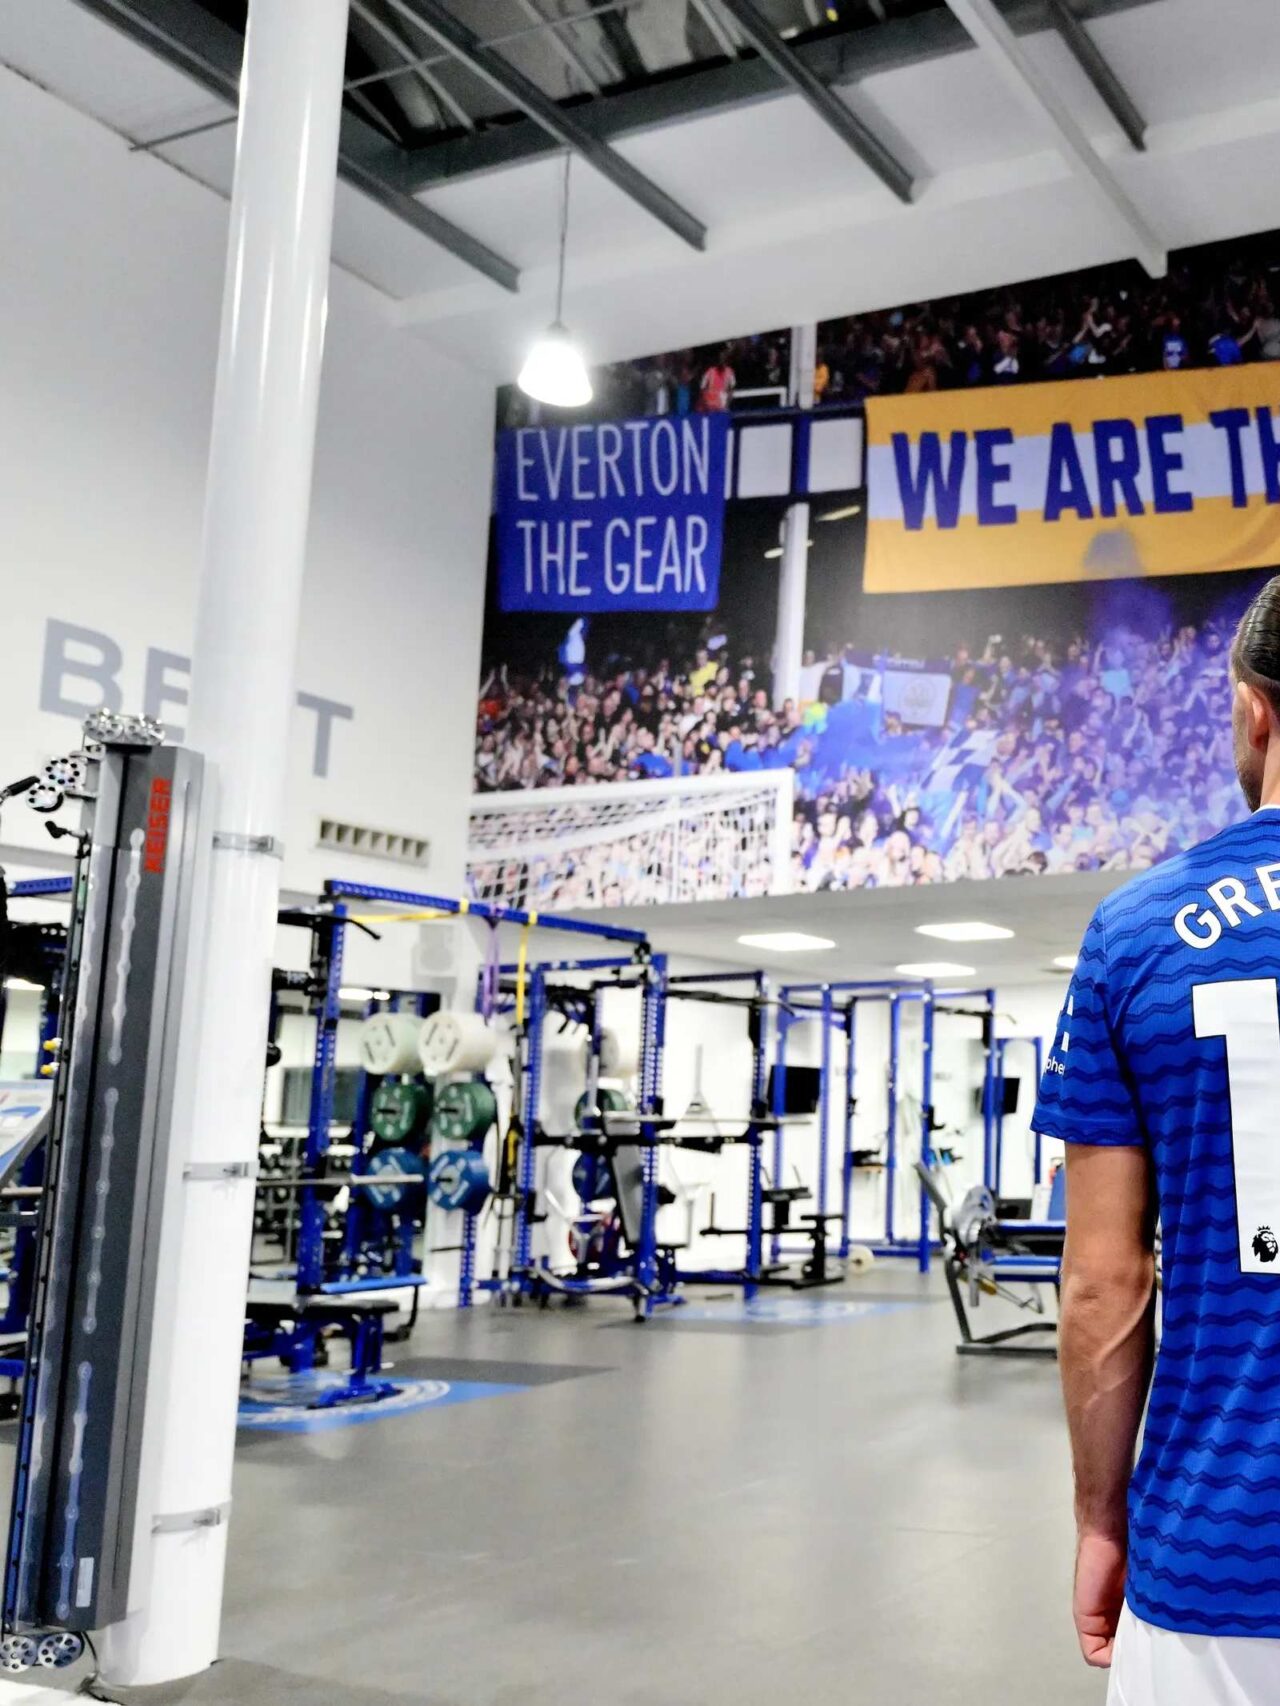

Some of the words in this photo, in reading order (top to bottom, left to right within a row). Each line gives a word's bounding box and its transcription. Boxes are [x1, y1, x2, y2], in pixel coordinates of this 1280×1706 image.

[516, 416, 709, 501] EVERTON
[891, 428, 1017, 530] WE
[1043, 413, 1193, 521] ARE
[516, 519, 592, 596] THE
[604, 515, 708, 595] GEAR
[39, 617, 355, 778] BET
